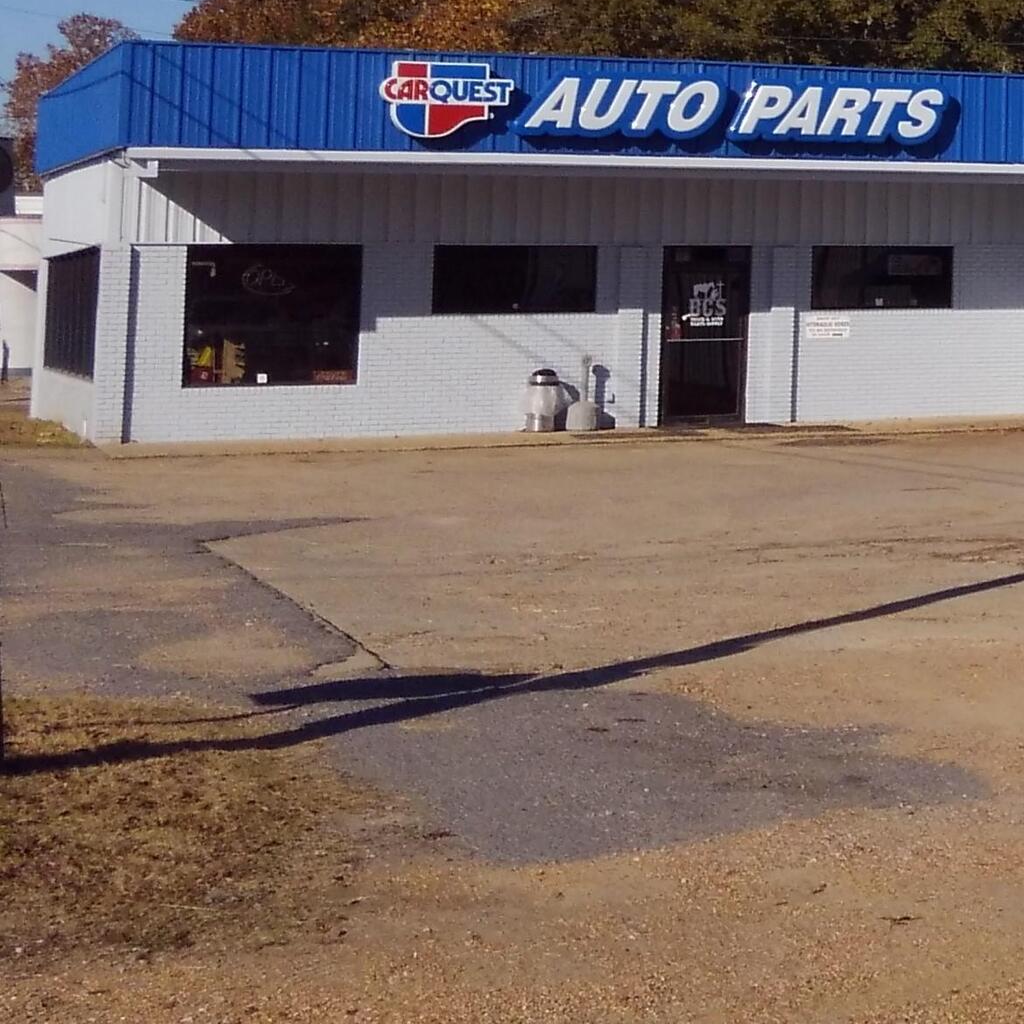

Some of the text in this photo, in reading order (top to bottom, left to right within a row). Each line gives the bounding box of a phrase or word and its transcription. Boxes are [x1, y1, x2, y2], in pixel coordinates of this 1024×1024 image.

[384, 78, 511, 103] CARQUEST
[524, 77, 944, 139] AUTO PARTS
